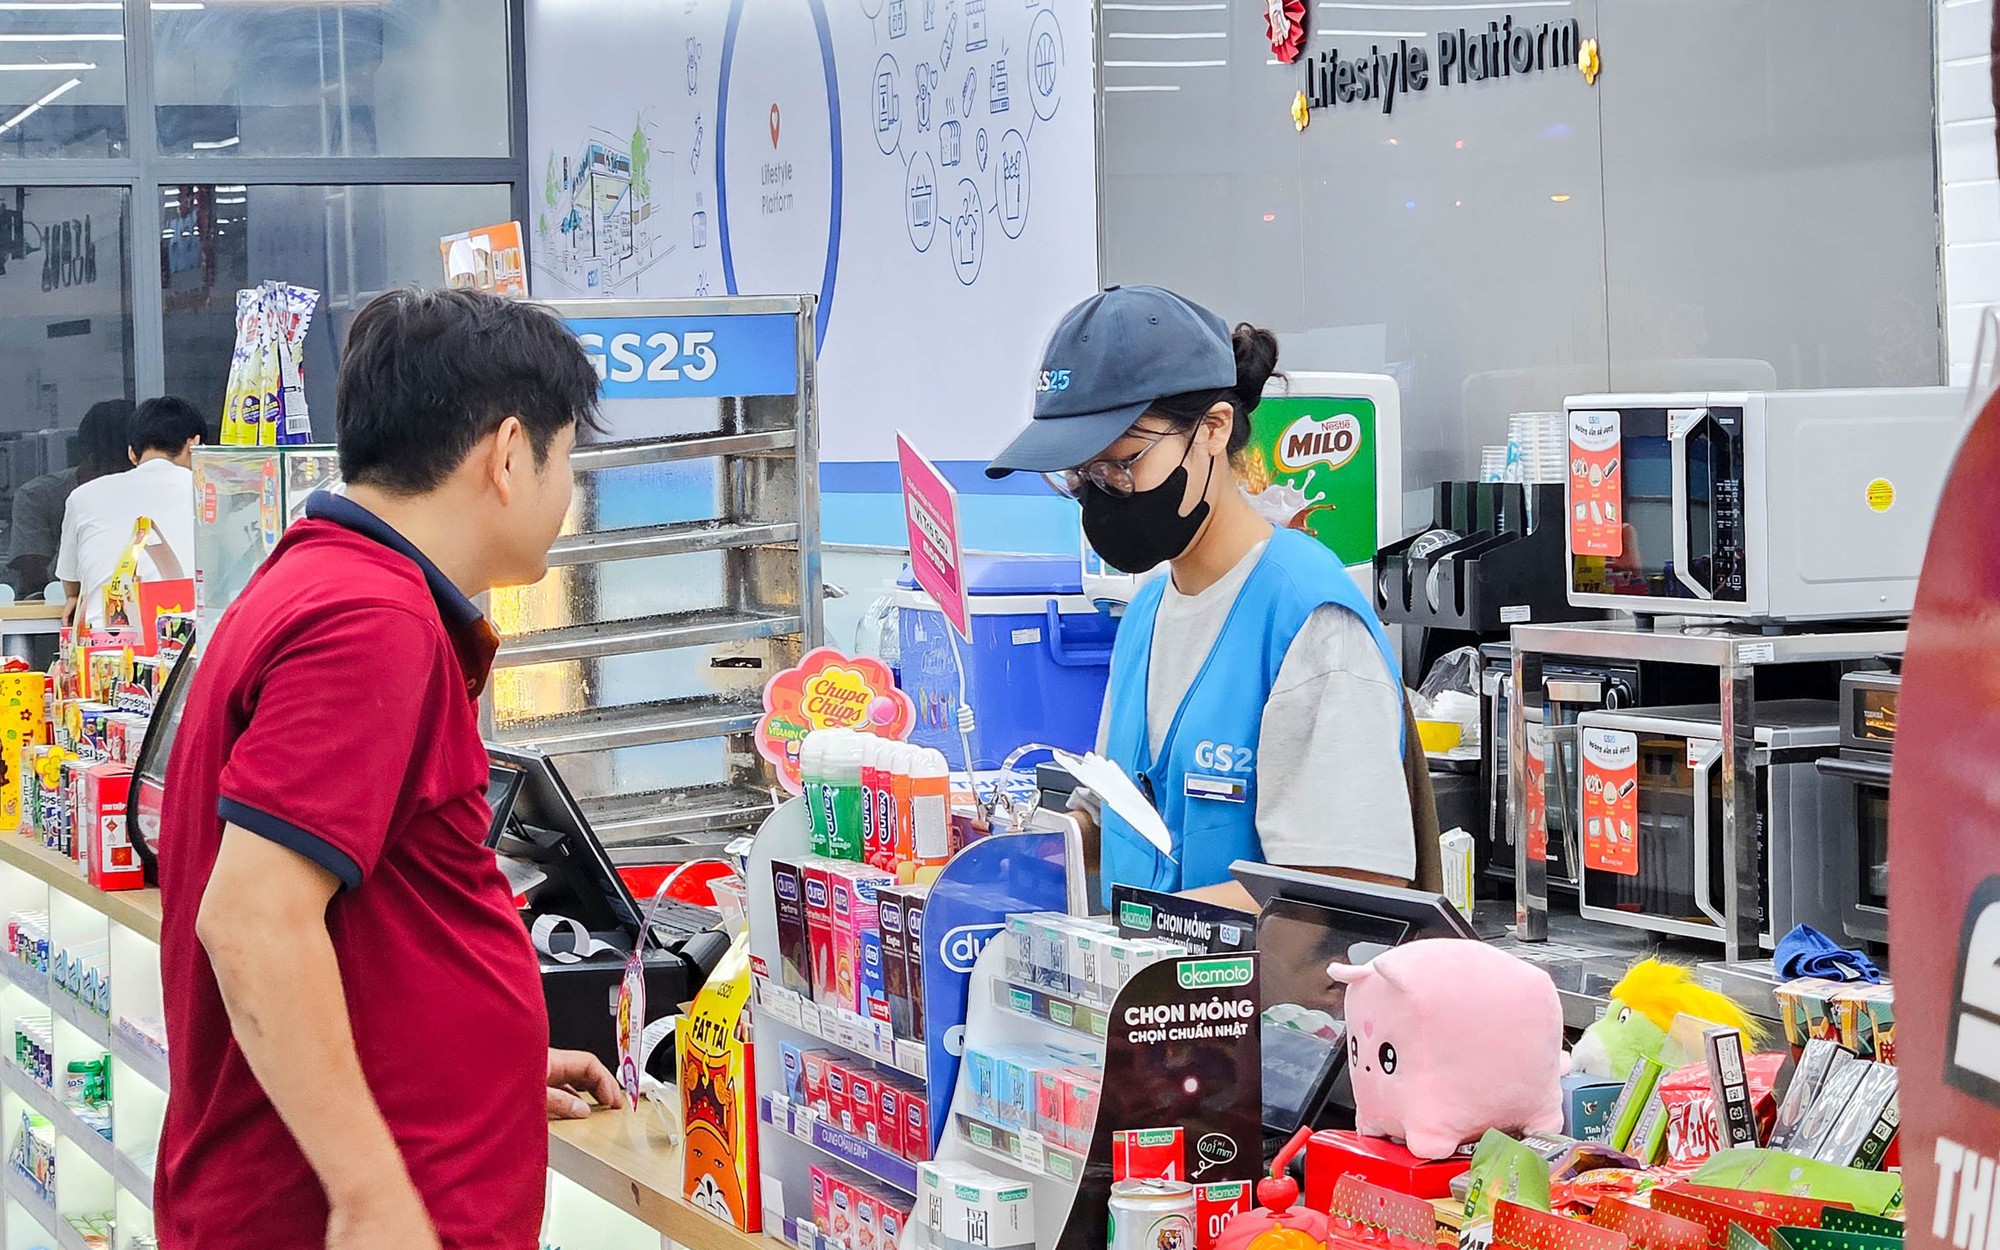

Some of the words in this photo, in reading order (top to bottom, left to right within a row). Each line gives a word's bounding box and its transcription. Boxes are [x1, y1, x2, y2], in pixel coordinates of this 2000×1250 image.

[1305, 39, 1429, 114] Lifestyle
[1437, 14, 1580, 87] Platform
[761, 161, 793, 186] Lifestyle
[762, 192, 794, 215] Platform
[576, 332, 718, 382] GS25
[1287, 430, 1353, 459] MILO
[814, 680, 868, 704] Chupa
[807, 696, 862, 727] Chups
[768, 726, 799, 740] VITAMIN
[1194, 739, 1254, 773] GS2
[822, 788, 835, 836] durex
[863, 789, 872, 837] durex
[880, 793, 889, 841] durex
[778, 879, 798, 895] durex
[807, 884, 826, 901] durex
[882, 907, 901, 929] durex
[1122, 906, 1150, 928] okamoto
[1156, 912, 1183, 937] CHỌN
[1184, 912, 1211, 940] MỎNG
[1181, 965, 1249, 985] okamoto
[1124, 1004, 1185, 1029] CHỌN
[1190, 996, 1254, 1021] MỎNG
[692, 1011, 713, 1043] FÁT
[711, 1018, 729, 1051] TÀI
[1128, 1029, 1166, 1045] CHỌN
[1168, 1022, 1213, 1041] CHUẨN
[1215, 1021, 1248, 1039] NHẬT
[1129, 1135, 1136, 1143] 4
[1139, 1134, 1172, 1145] okamoto
[1584, 1125, 1601, 1135] Tinh
[1668, 1099, 1719, 1157] KitKa
[1217, 1147, 1233, 1158] mm
[997, 1190, 1028, 1202] okamoto
[1198, 1189, 1204, 1198] 2
[1208, 1187, 1240, 1199] okamoto
[1932, 1134, 2000, 1250] TH
